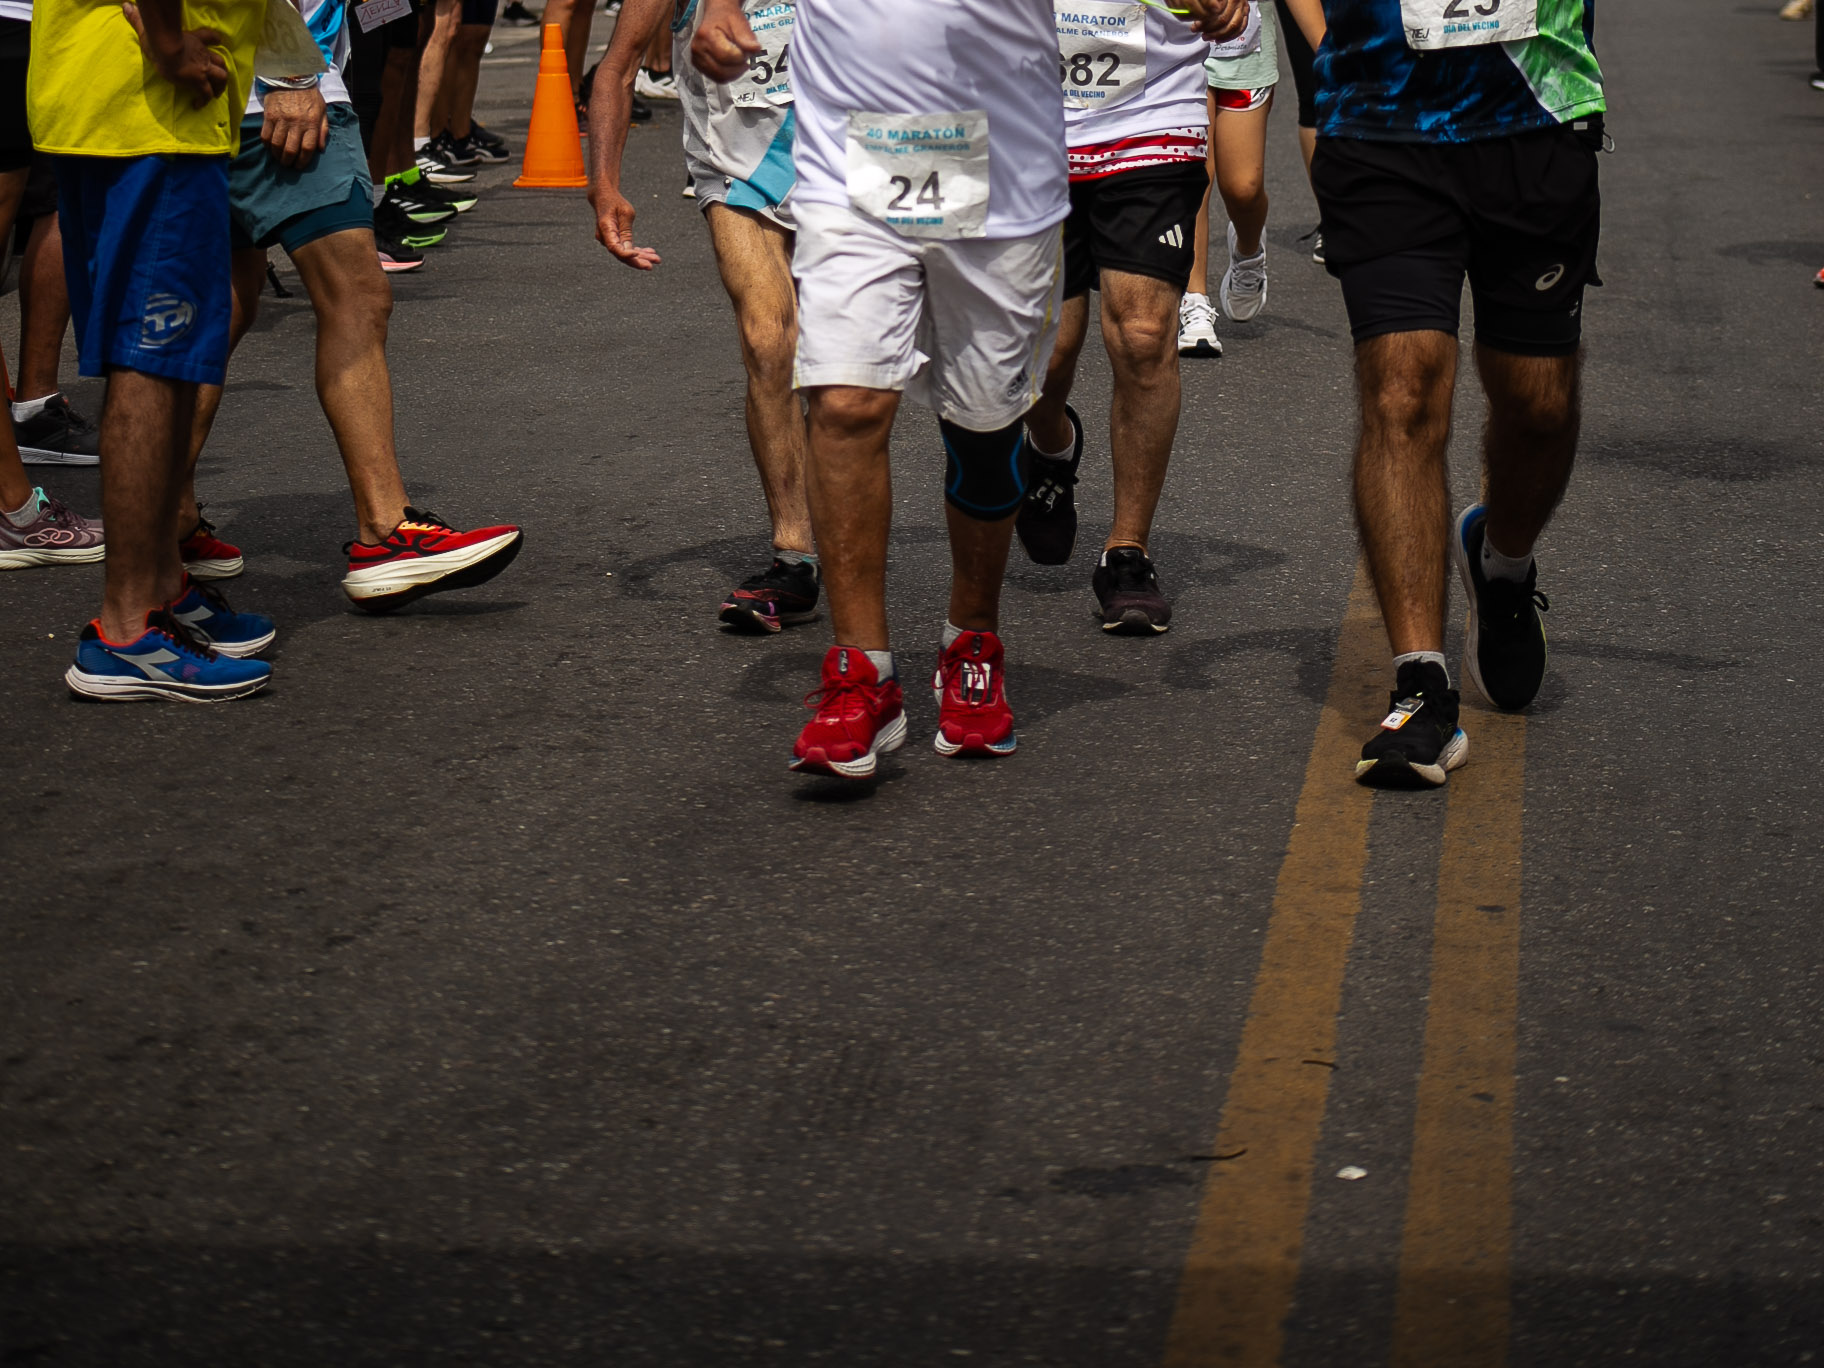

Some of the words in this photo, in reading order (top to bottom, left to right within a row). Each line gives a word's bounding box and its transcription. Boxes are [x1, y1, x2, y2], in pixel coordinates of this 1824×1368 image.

[754, 4, 792, 19] MARA
[1061, 12, 1126, 26] MARATON
[1056, 27, 1078, 36] ALME
[1443, 25, 1456, 34] DIA
[1457, 23, 1471, 32] DEL
[1472, 20, 1499, 30] VECINO
[1081, 91, 1105, 99] VECINO
[866, 128, 883, 139] 40
[888, 127, 965, 141] MARATON
[888, 171, 945, 211] 24
